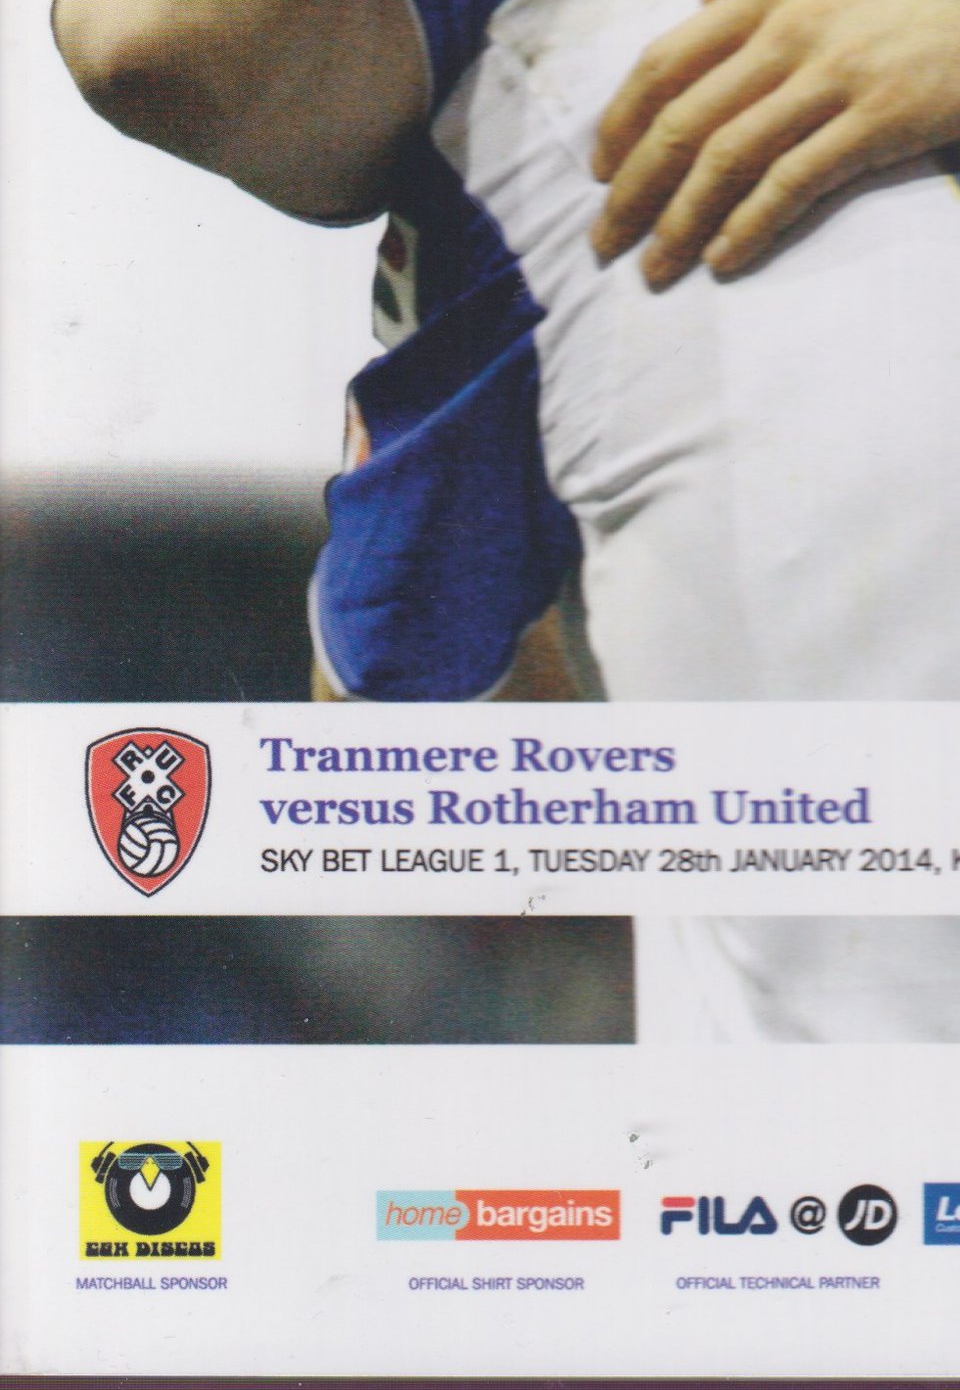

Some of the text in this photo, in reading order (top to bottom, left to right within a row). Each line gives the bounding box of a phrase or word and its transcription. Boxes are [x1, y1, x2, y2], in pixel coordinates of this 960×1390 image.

[260, 738, 676, 772] Tranmere Rovers
[259, 787, 872, 825] versus Rotherham United
[261, 848, 313, 872] SKY
[323, 849, 372, 872] BET
[381, 849, 484, 873] LEAGUE
[494, 849, 519, 876] 1,
[528, 849, 651, 873] TUESDAY
[659, 848, 721, 873] 28th
[729, 848, 852, 872] JANUARY
[859, 848, 941, 875] 2014,
[385, 1200, 613, 1233] home bargains
[661, 1196, 893, 1235] FILA @ JD
[76, 1277, 228, 1290] MATCHBALL SPONSOR
[408, 1277, 585, 1290] OFFICIAL SHIRT SPONSOR
[676, 1276, 880, 1290] OFFICIAL TECHNICAL PARTNER
